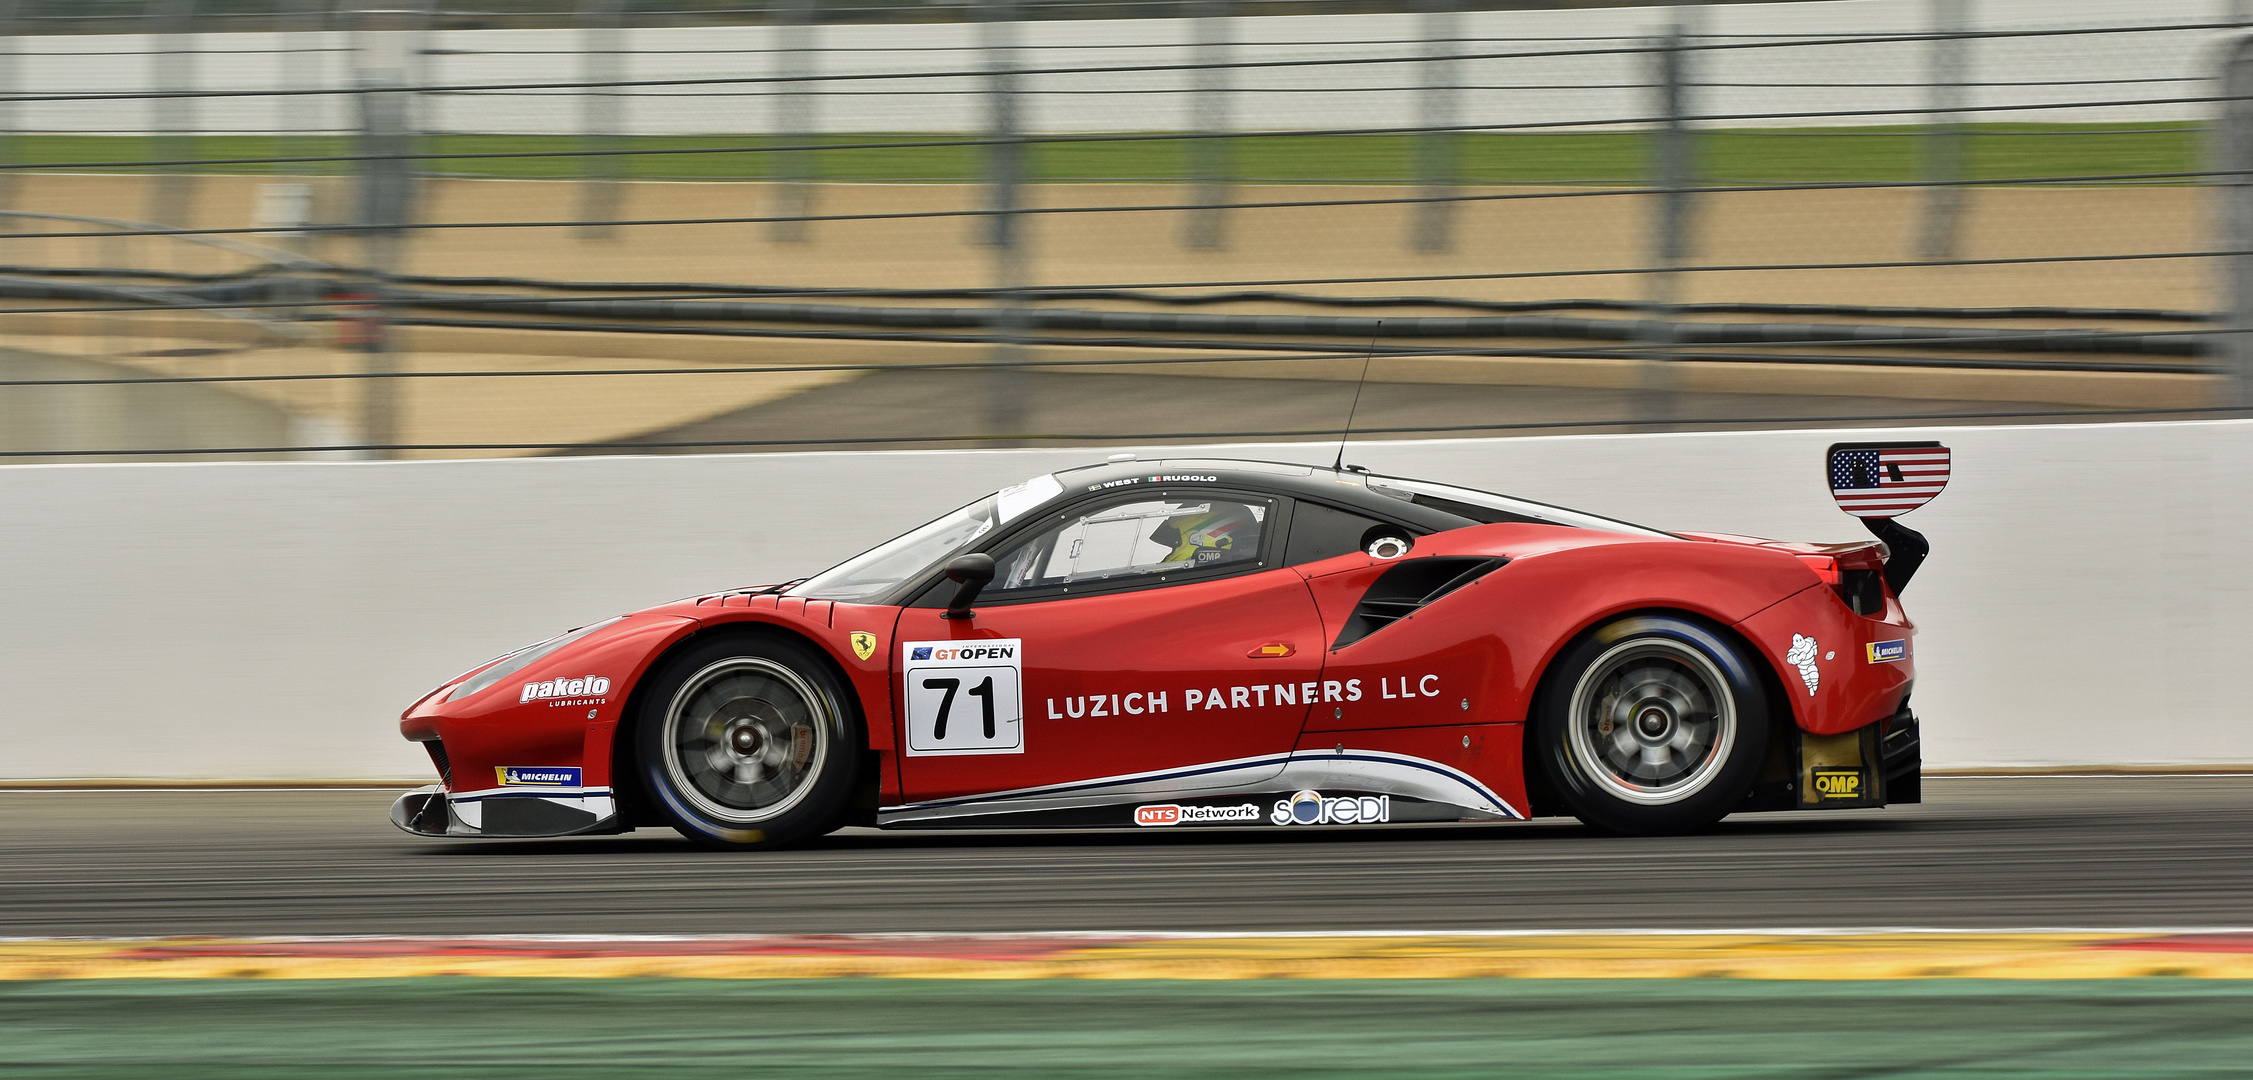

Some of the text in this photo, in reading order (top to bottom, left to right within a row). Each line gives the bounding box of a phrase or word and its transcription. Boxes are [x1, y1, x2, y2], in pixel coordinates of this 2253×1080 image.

[1103, 478, 1139, 488] WEST
[1198, 553, 1220, 561] OMP
[519, 675, 610, 704] pakelo
[549, 699, 606, 707] LUBRICANTS
[1047, 674, 1440, 720] LUZICH PARTNERS LLC
[922, 676, 996, 740] 71
[521, 773, 572, 781] MICHELIN
[1816, 776, 1859, 793] OMP
[1141, 806, 1255, 820] NTS Network
